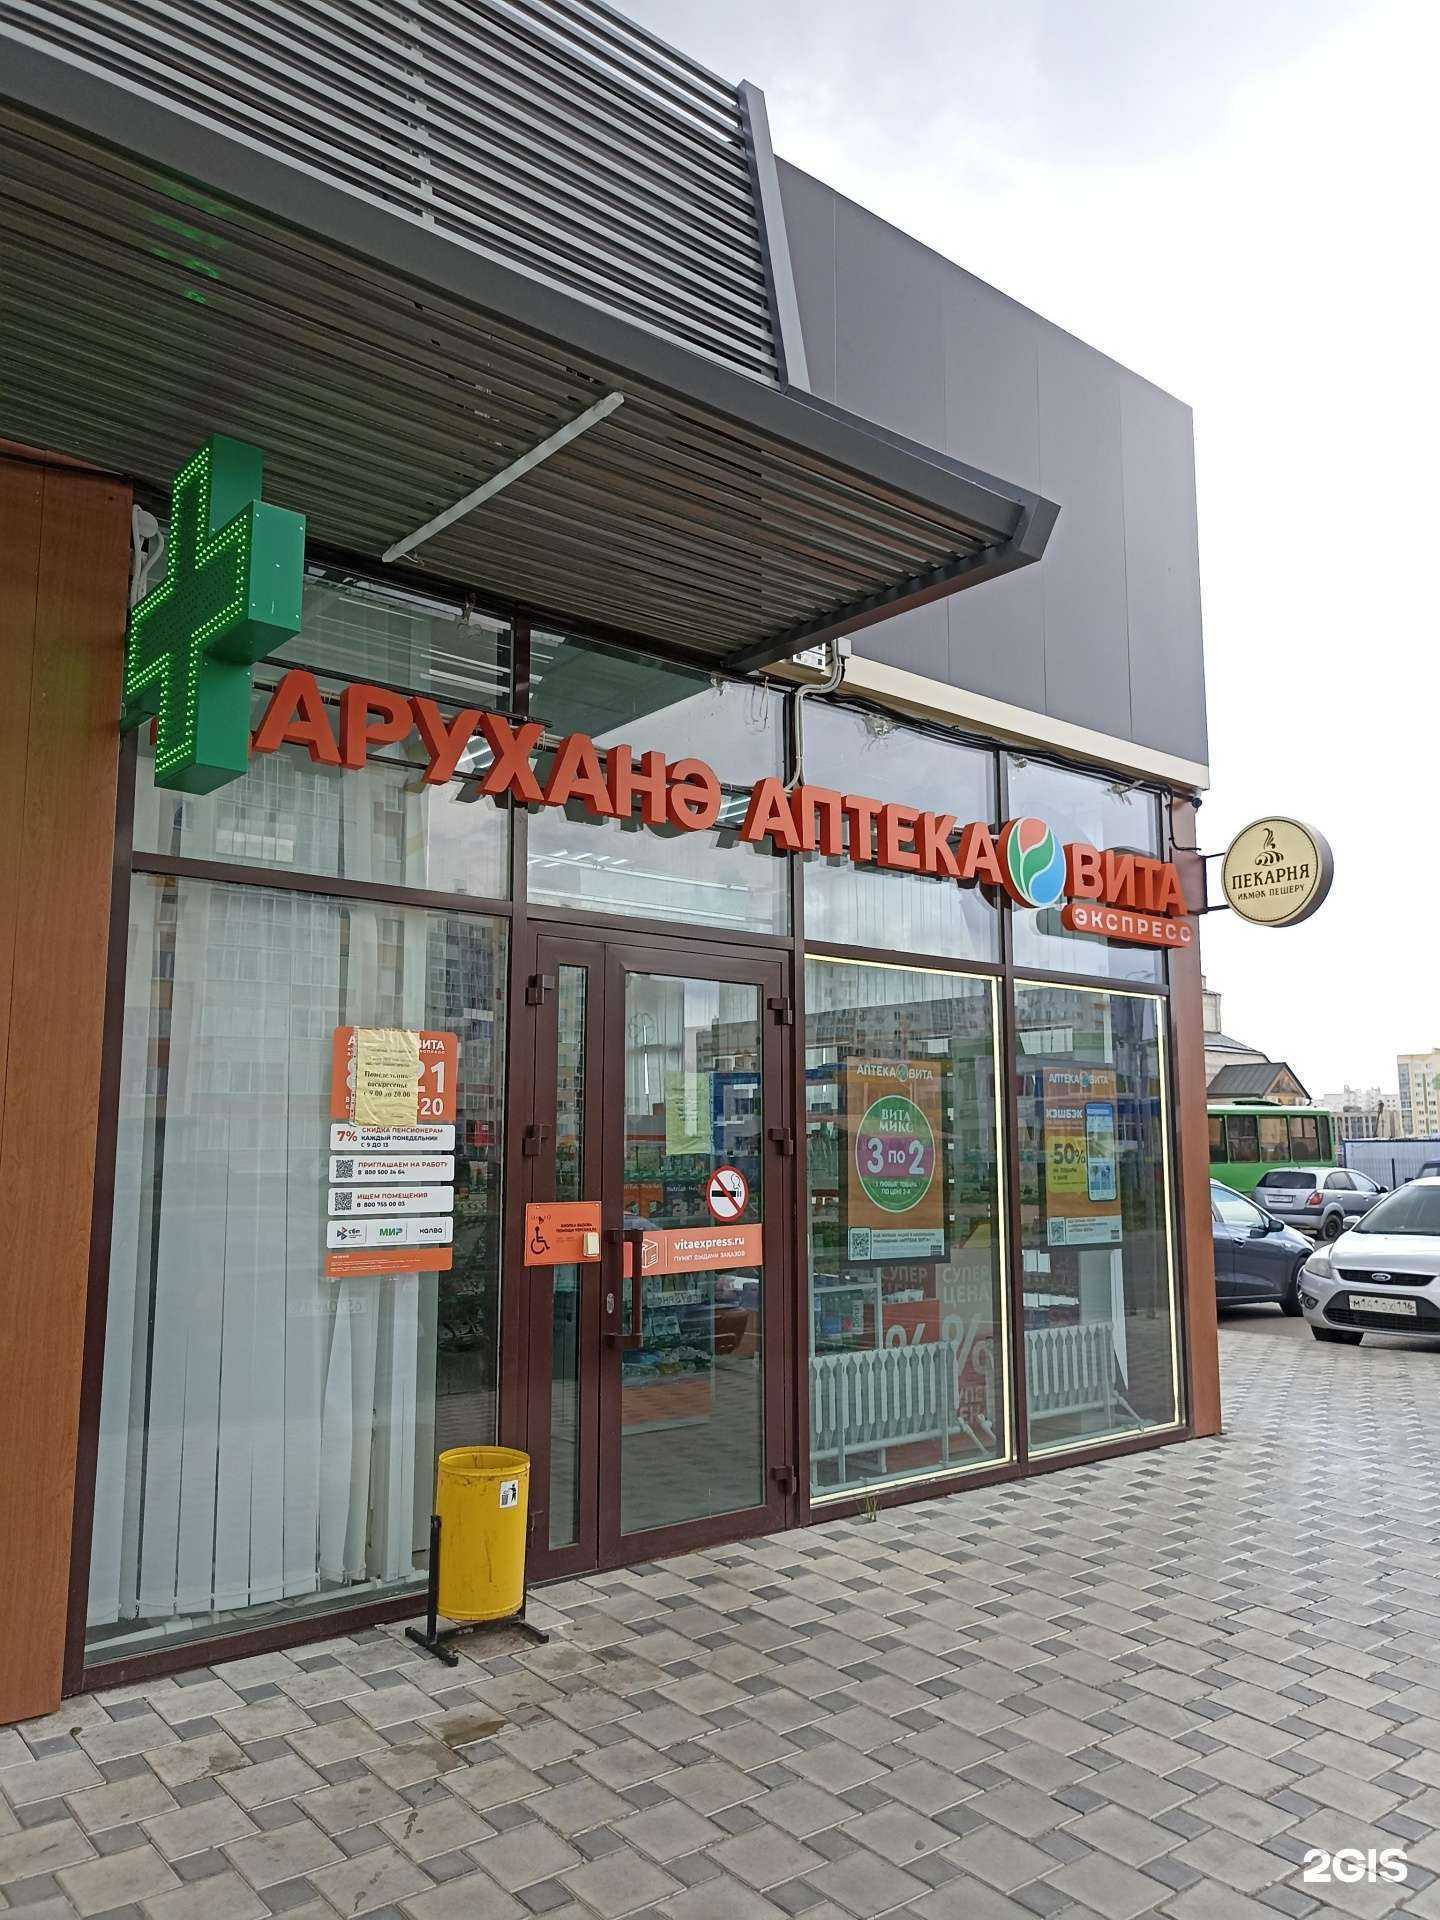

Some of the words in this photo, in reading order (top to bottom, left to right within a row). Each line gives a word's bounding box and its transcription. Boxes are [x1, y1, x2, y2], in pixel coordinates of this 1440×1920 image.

[254, 669, 722, 831] АРУХАНӘ
[741, 777, 1003, 885] АПТЕКА
[1064, 843, 1188, 917] ВИТА
[1232, 863, 1310, 890] ПЕКАРНЯ
[1073, 908, 1192, 942] ЭКСПРЕСС
[856, 1063, 896, 1077] АПТЕКА
[908, 1068, 933, 1080] ВИТА
[1048, 1073, 1080, 1084] АПТЕКА
[881, 1108, 911, 1121] ВИТА
[337, 1130, 358, 1142] 7%
[880, 1121, 914, 1133] МИКС
[867, 1137, 884, 1173] 3
[888, 1150, 906, 1164] ПО
[908, 1139, 925, 1175] 2
[379, 1227, 403, 1237] МИР
[674, 1236, 745, 1251] vitaexpress.ru
[882, 1265, 927, 1283] СУПЕР
[943, 1265, 993, 1283] СУПЕР
[943, 1286, 993, 1310] ЦЕНА
